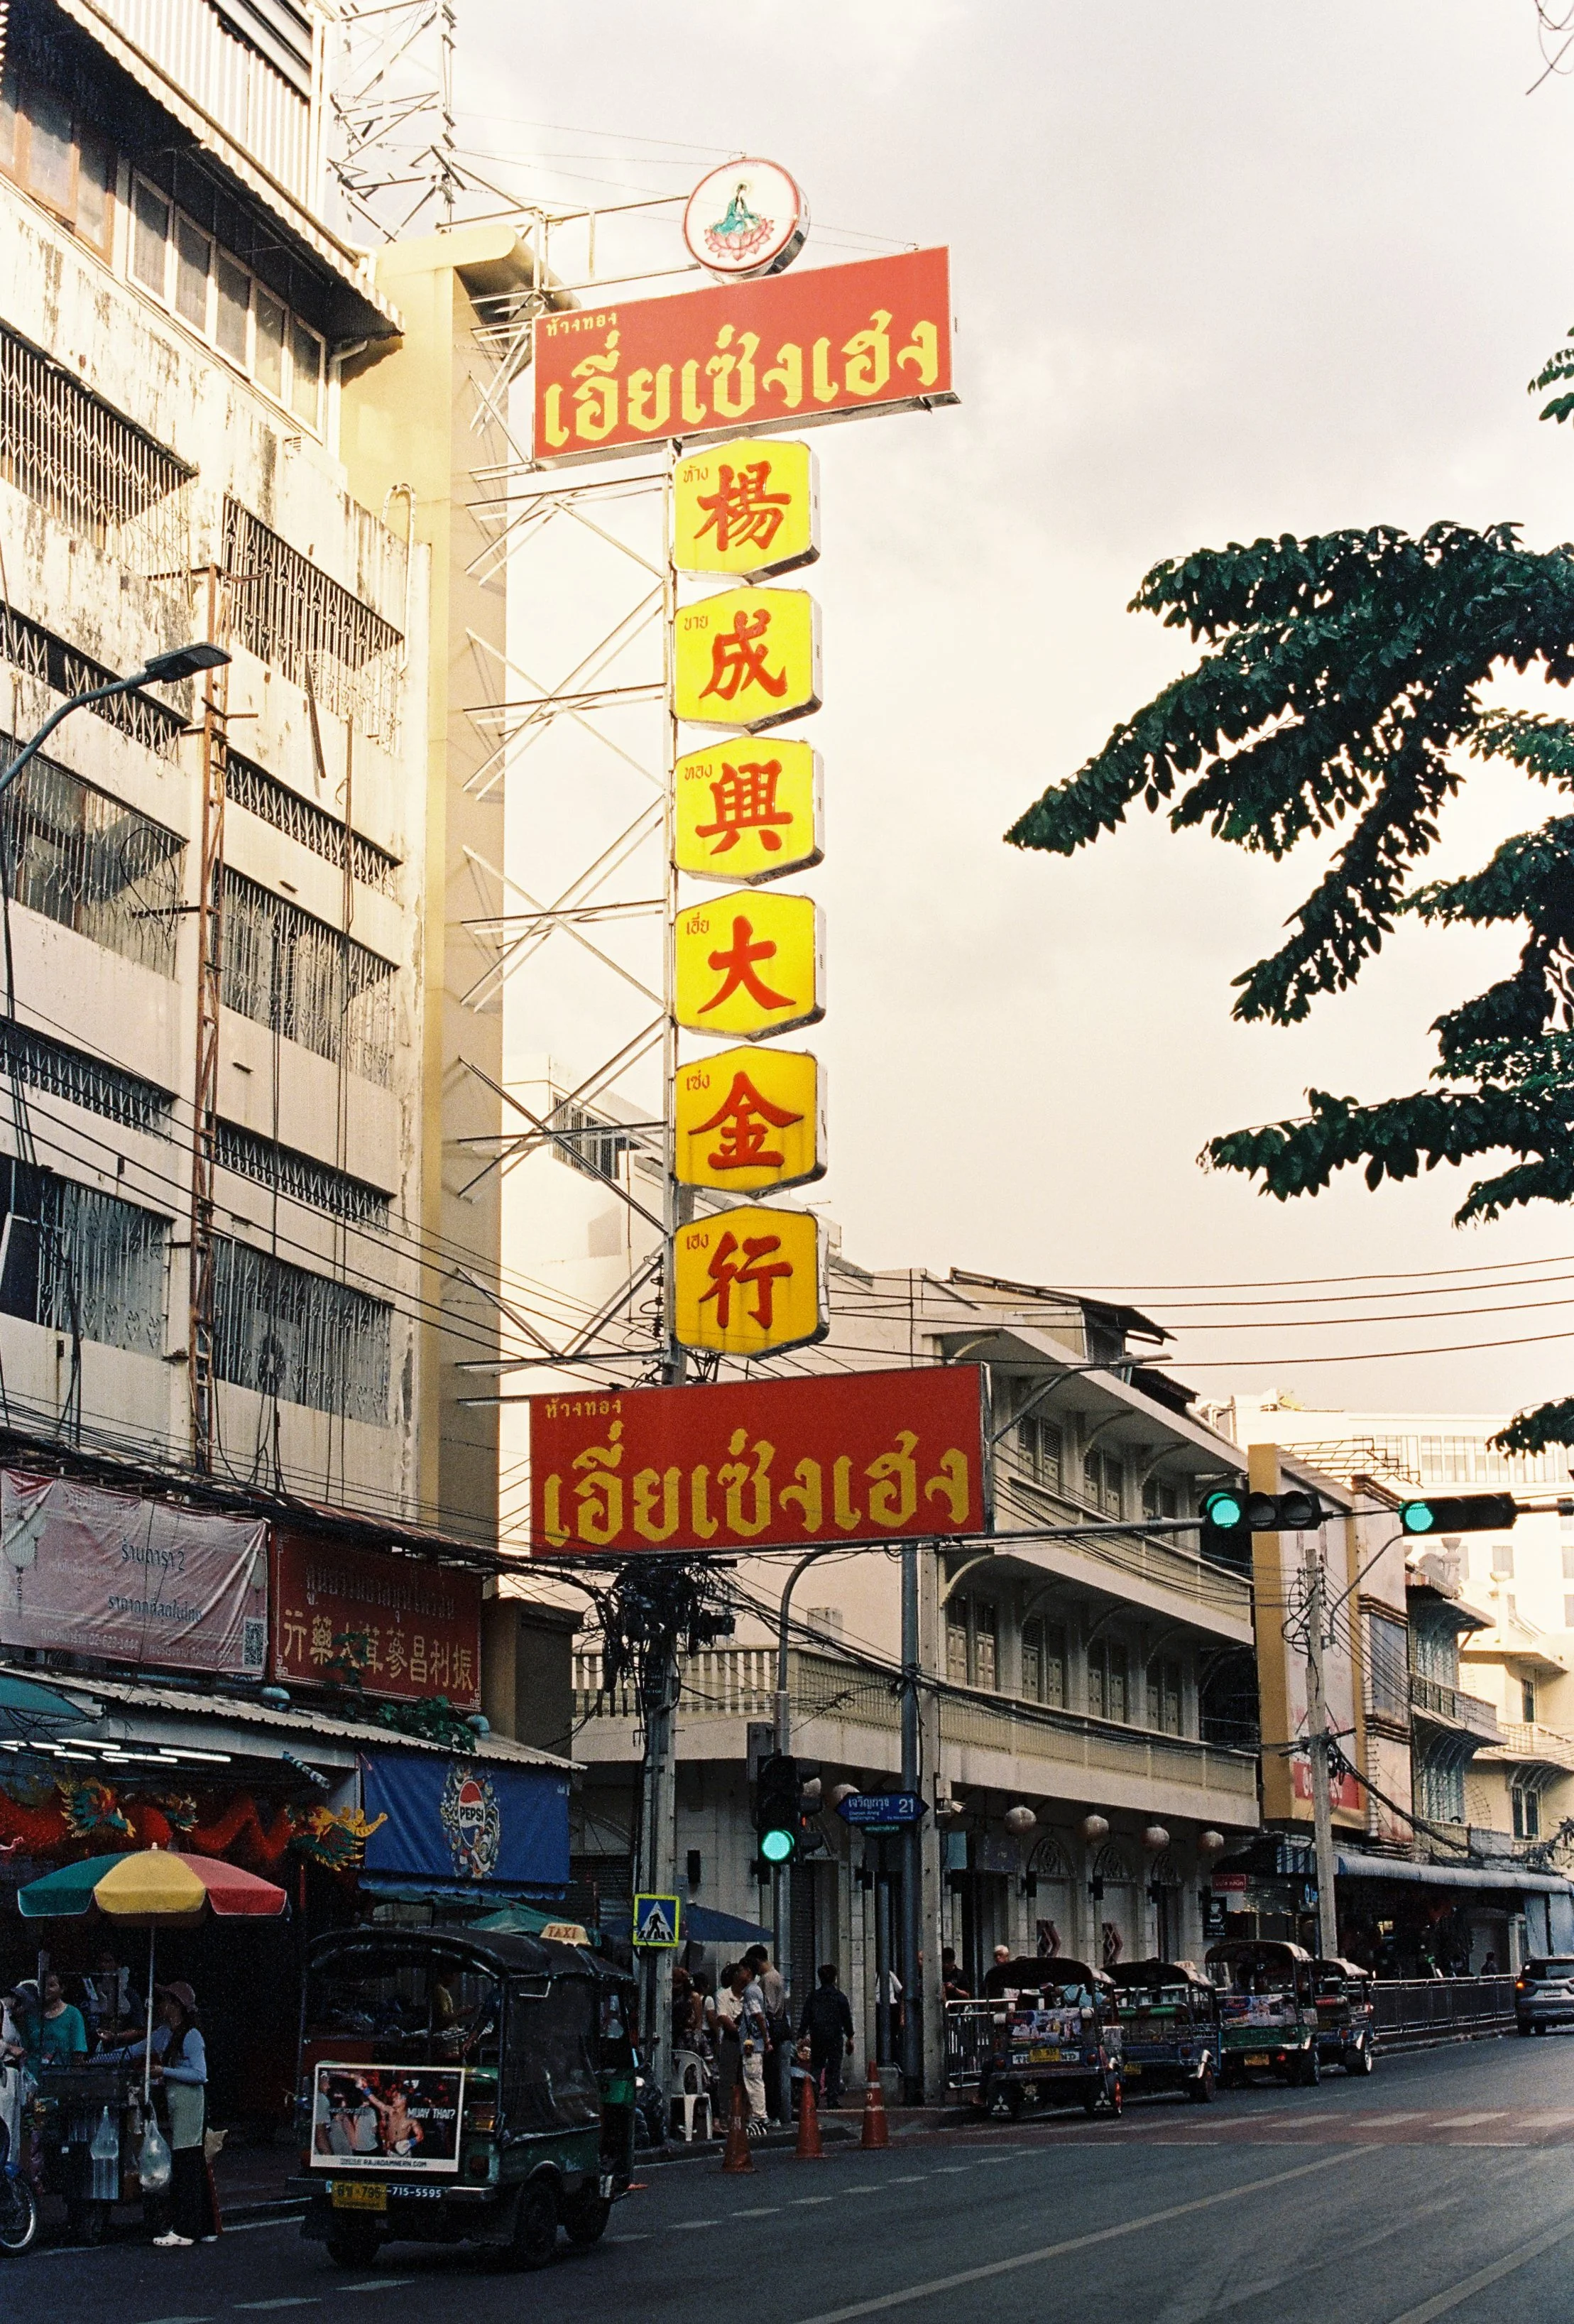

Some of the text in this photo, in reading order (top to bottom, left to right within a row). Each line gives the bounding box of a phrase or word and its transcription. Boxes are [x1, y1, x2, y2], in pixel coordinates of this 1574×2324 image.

[546, 312, 617, 337] ห้างทอง
[684, 464, 709, 483] ห้าง
[694, 460, 791, 552] 楊
[684, 616, 709, 631] ขาย
[699, 611, 787, 700] 成
[684, 764, 712, 780] ทอง
[695, 760, 793, 855] 興
[697, 915, 796, 1013] 大
[687, 1069, 710, 1091] เซ่ง
[688, 1071, 804, 1169] 金
[699, 1231, 793, 1329] 行
[545, 1397, 621, 1419] ห้างทอง
[177, 1551, 185, 1571] 2
[460, 1806, 484, 1821] PEPSI
[899, 1798, 914, 1813] 21
[548, 1925, 577, 1939] TAXI
[407, 2107, 456, 2120] MUAY THAI?
